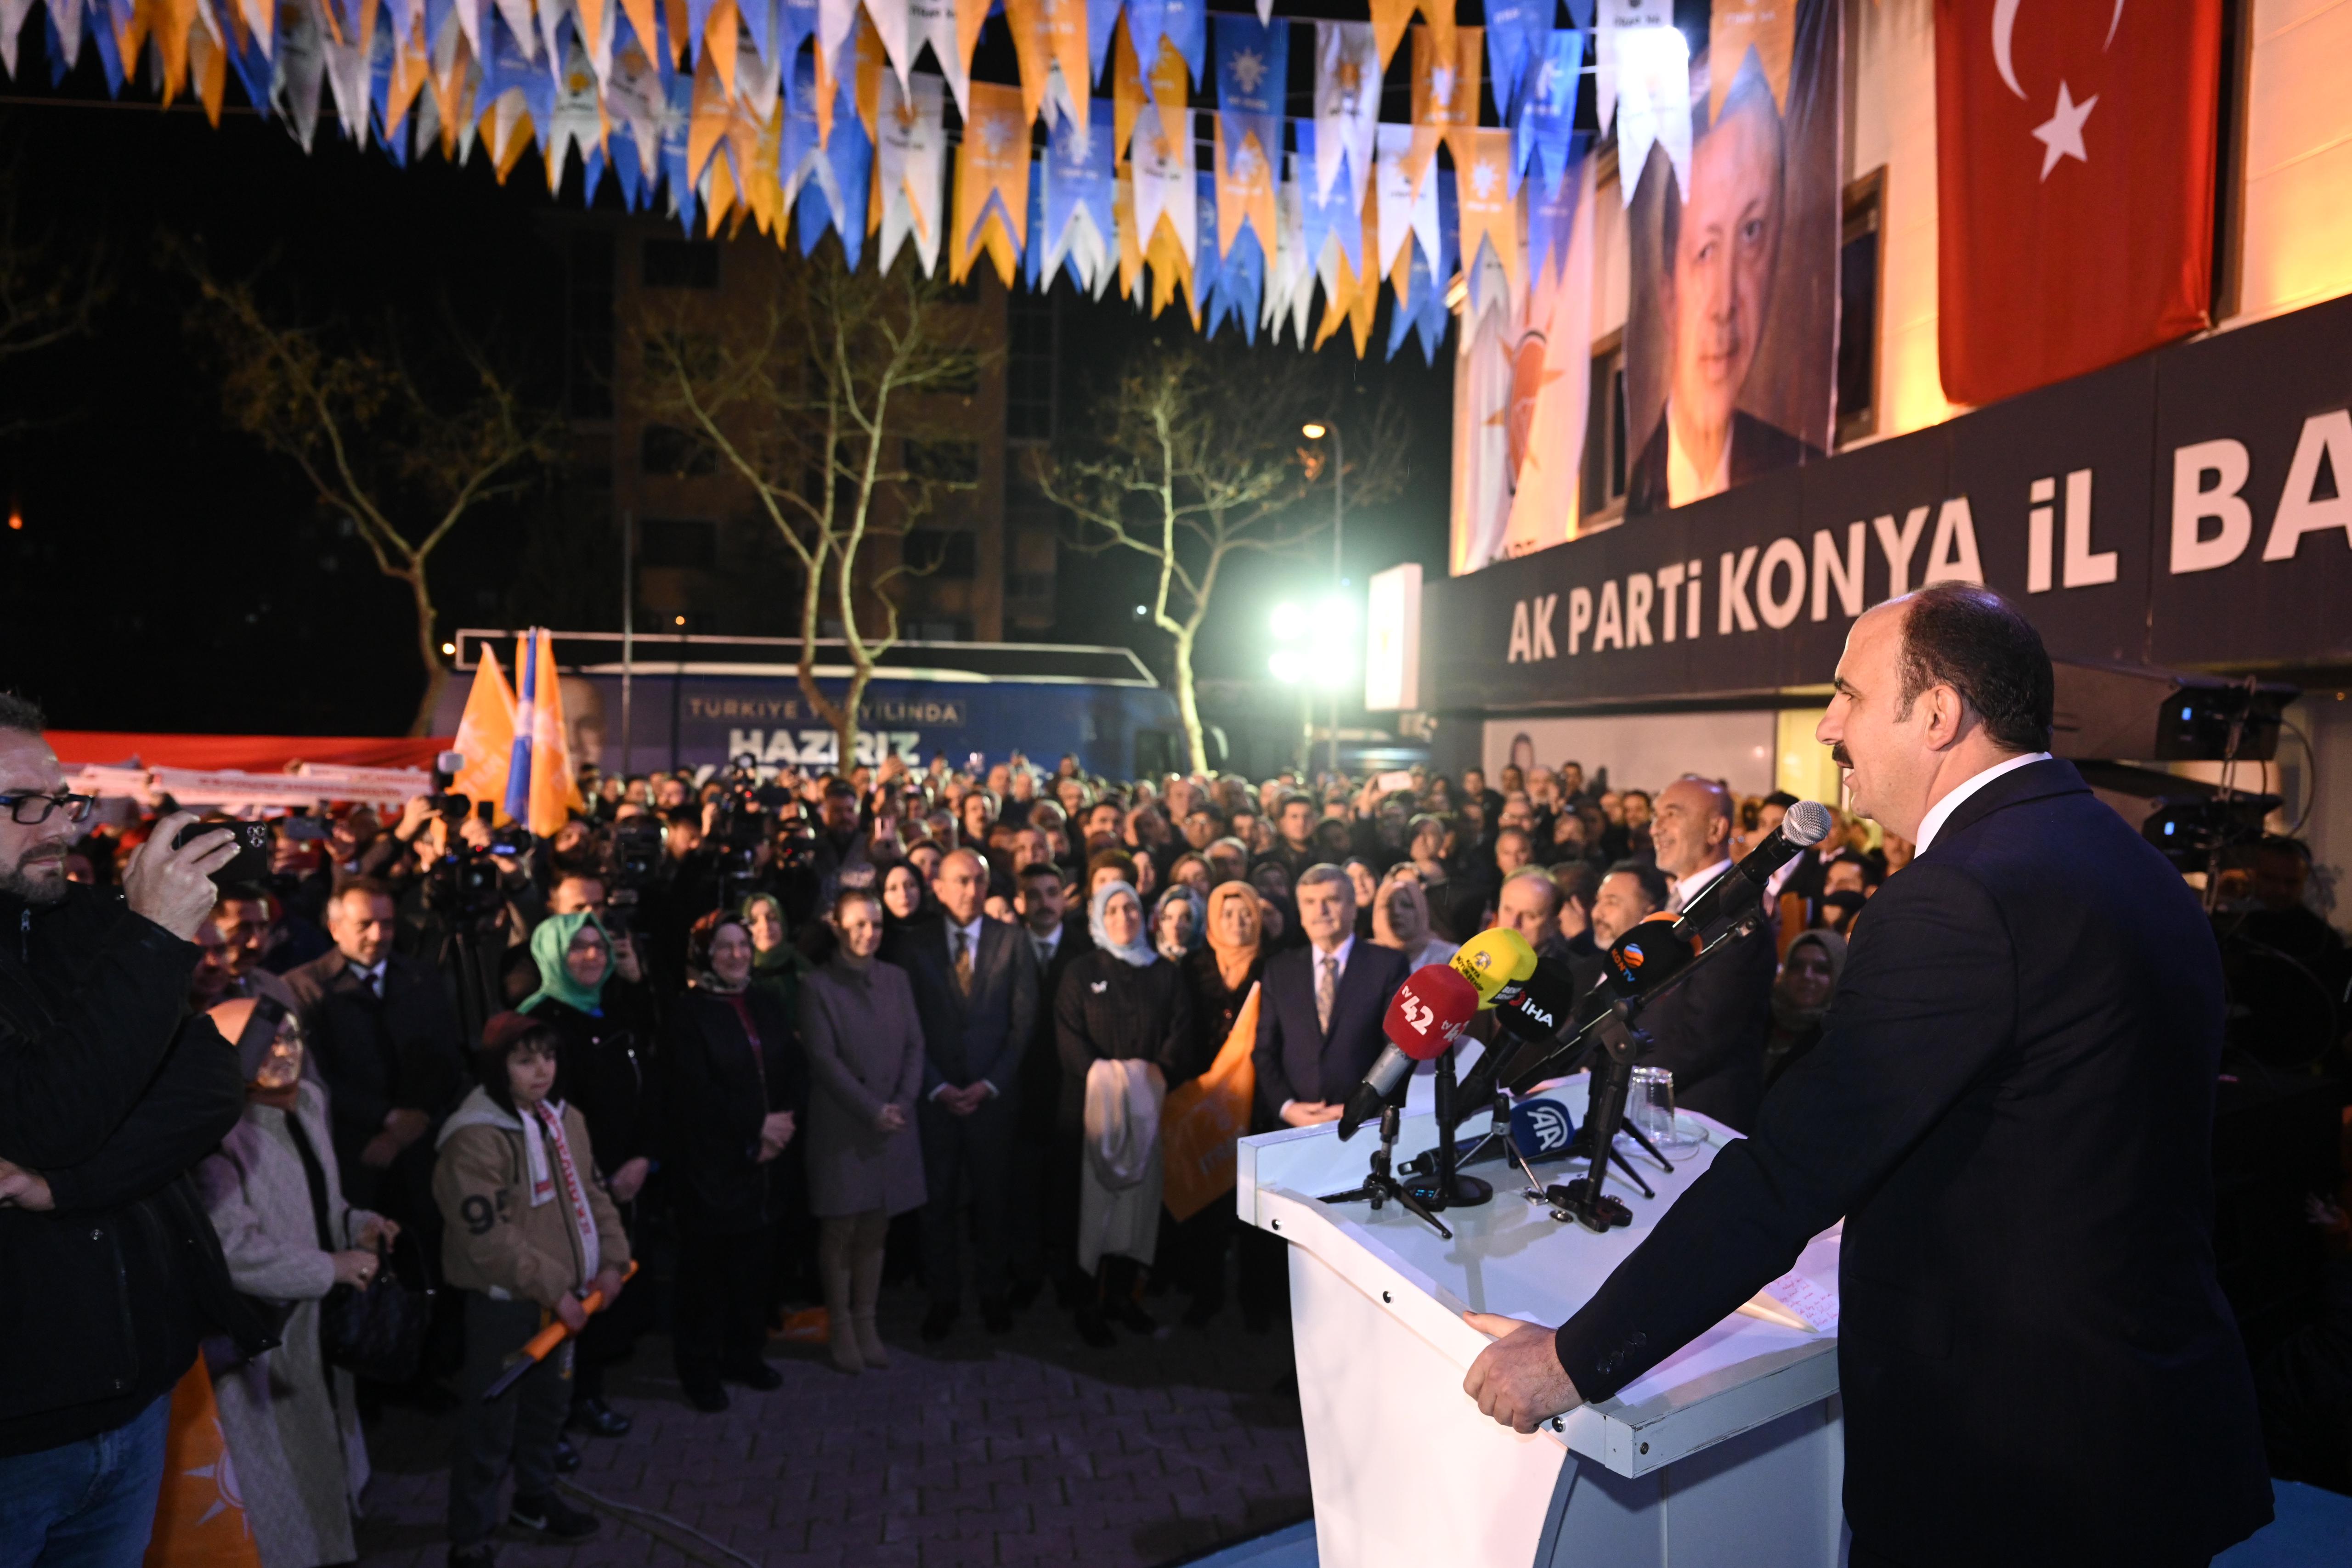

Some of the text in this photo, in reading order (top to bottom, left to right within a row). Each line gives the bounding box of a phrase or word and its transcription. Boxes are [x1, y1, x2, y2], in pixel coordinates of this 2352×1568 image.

[1507, 593, 1559, 664] AK
[1719, 496, 1984, 635] KONYA
[1466, 959, 1481, 979] KONYA
[1400, 995, 1434, 1036] 42
[1527, 1110, 1562, 1151] AA
